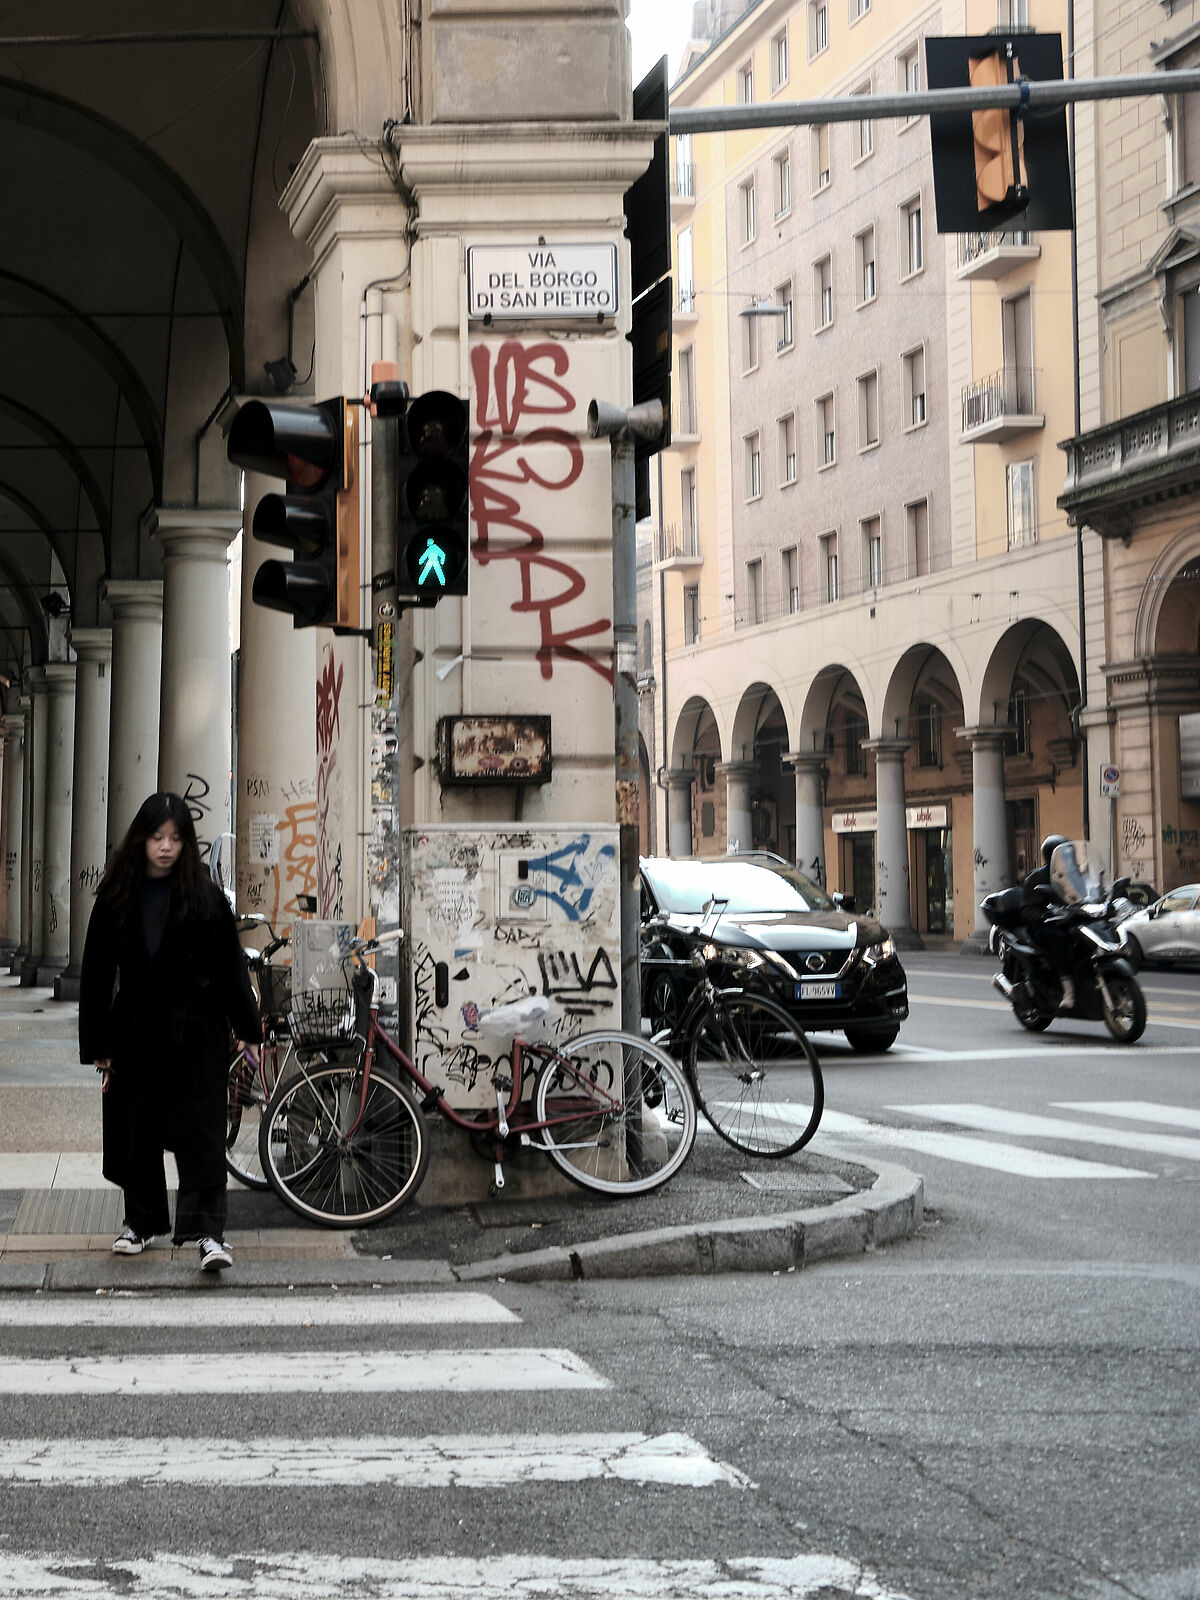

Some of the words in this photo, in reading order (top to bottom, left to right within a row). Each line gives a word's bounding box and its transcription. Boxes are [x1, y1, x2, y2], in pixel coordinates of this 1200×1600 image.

[527, 252, 557, 268] VIA
[488, 272, 525, 289] DEL
[529, 270, 598, 289] BORGO
[476, 292, 494, 309] DI
[499, 291, 538, 309] SAN
[543, 289, 611, 308] PIETRO
